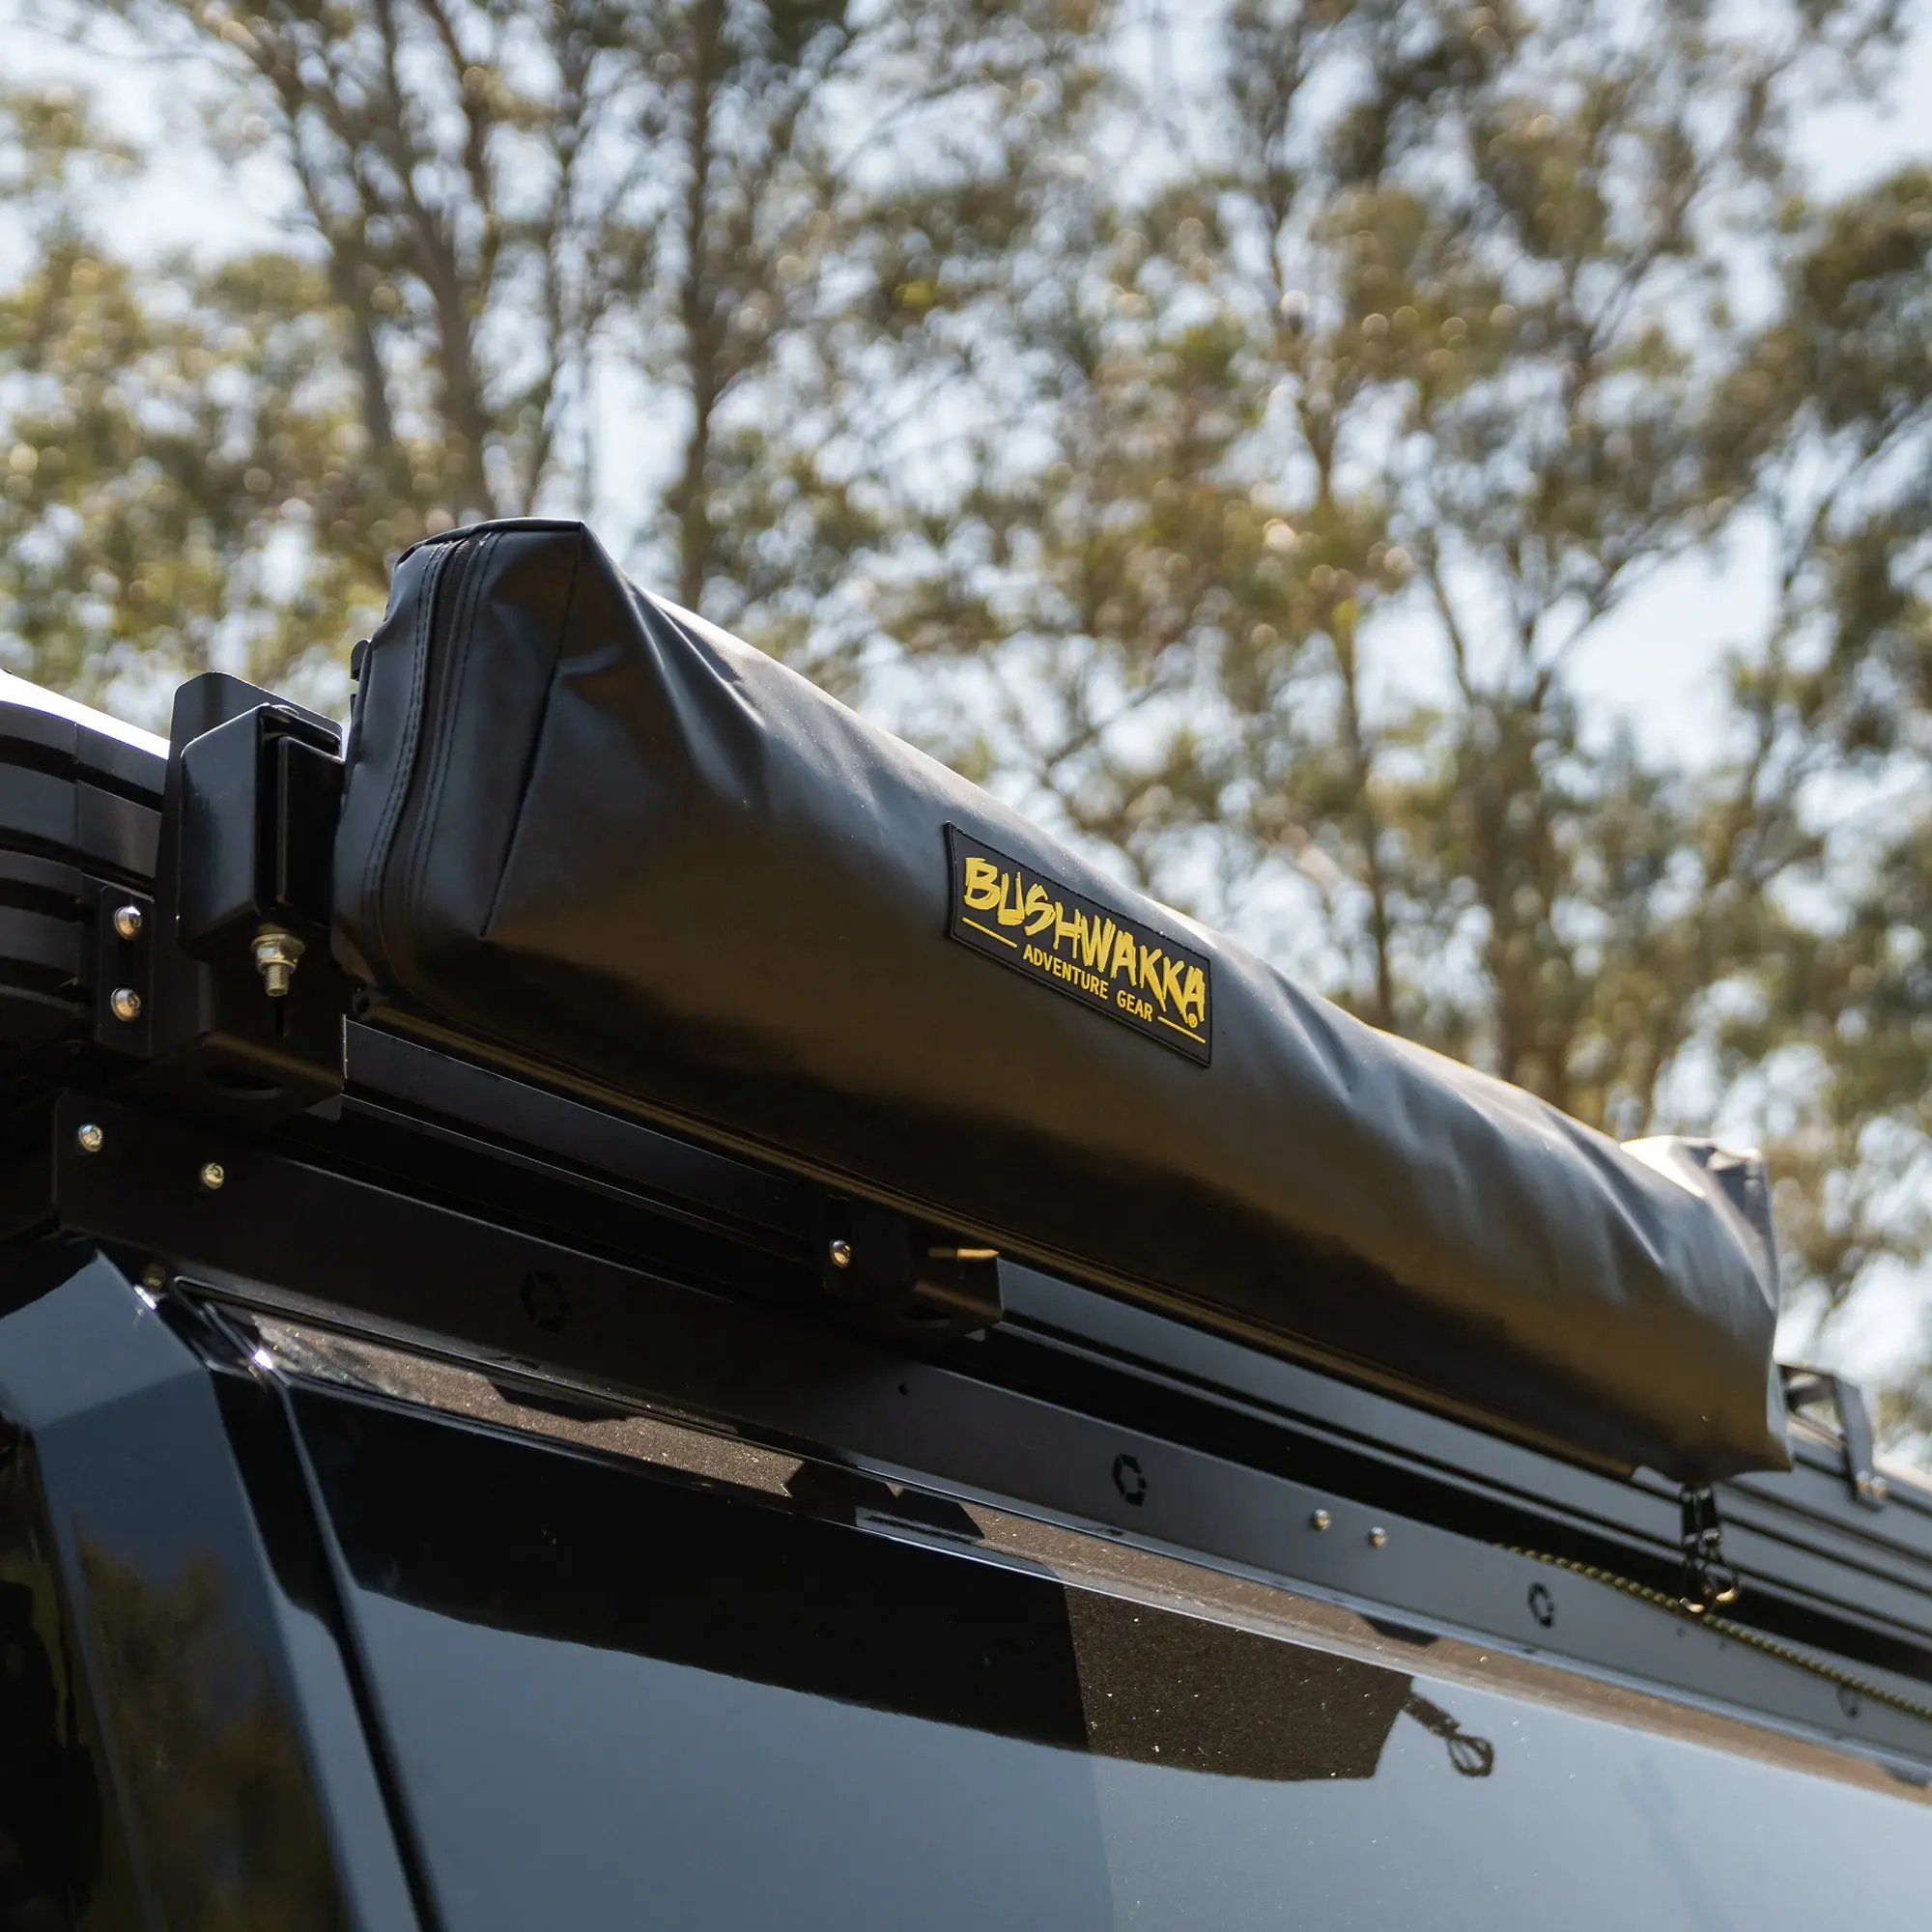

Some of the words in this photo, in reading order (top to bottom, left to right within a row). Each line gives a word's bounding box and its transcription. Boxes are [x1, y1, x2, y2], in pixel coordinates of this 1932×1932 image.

[963, 857, 1206, 1024] BUSHWAKKA
[1022, 943, 1109, 1000] ADVENTURE
[1116, 989, 1153, 1022] GEAR
